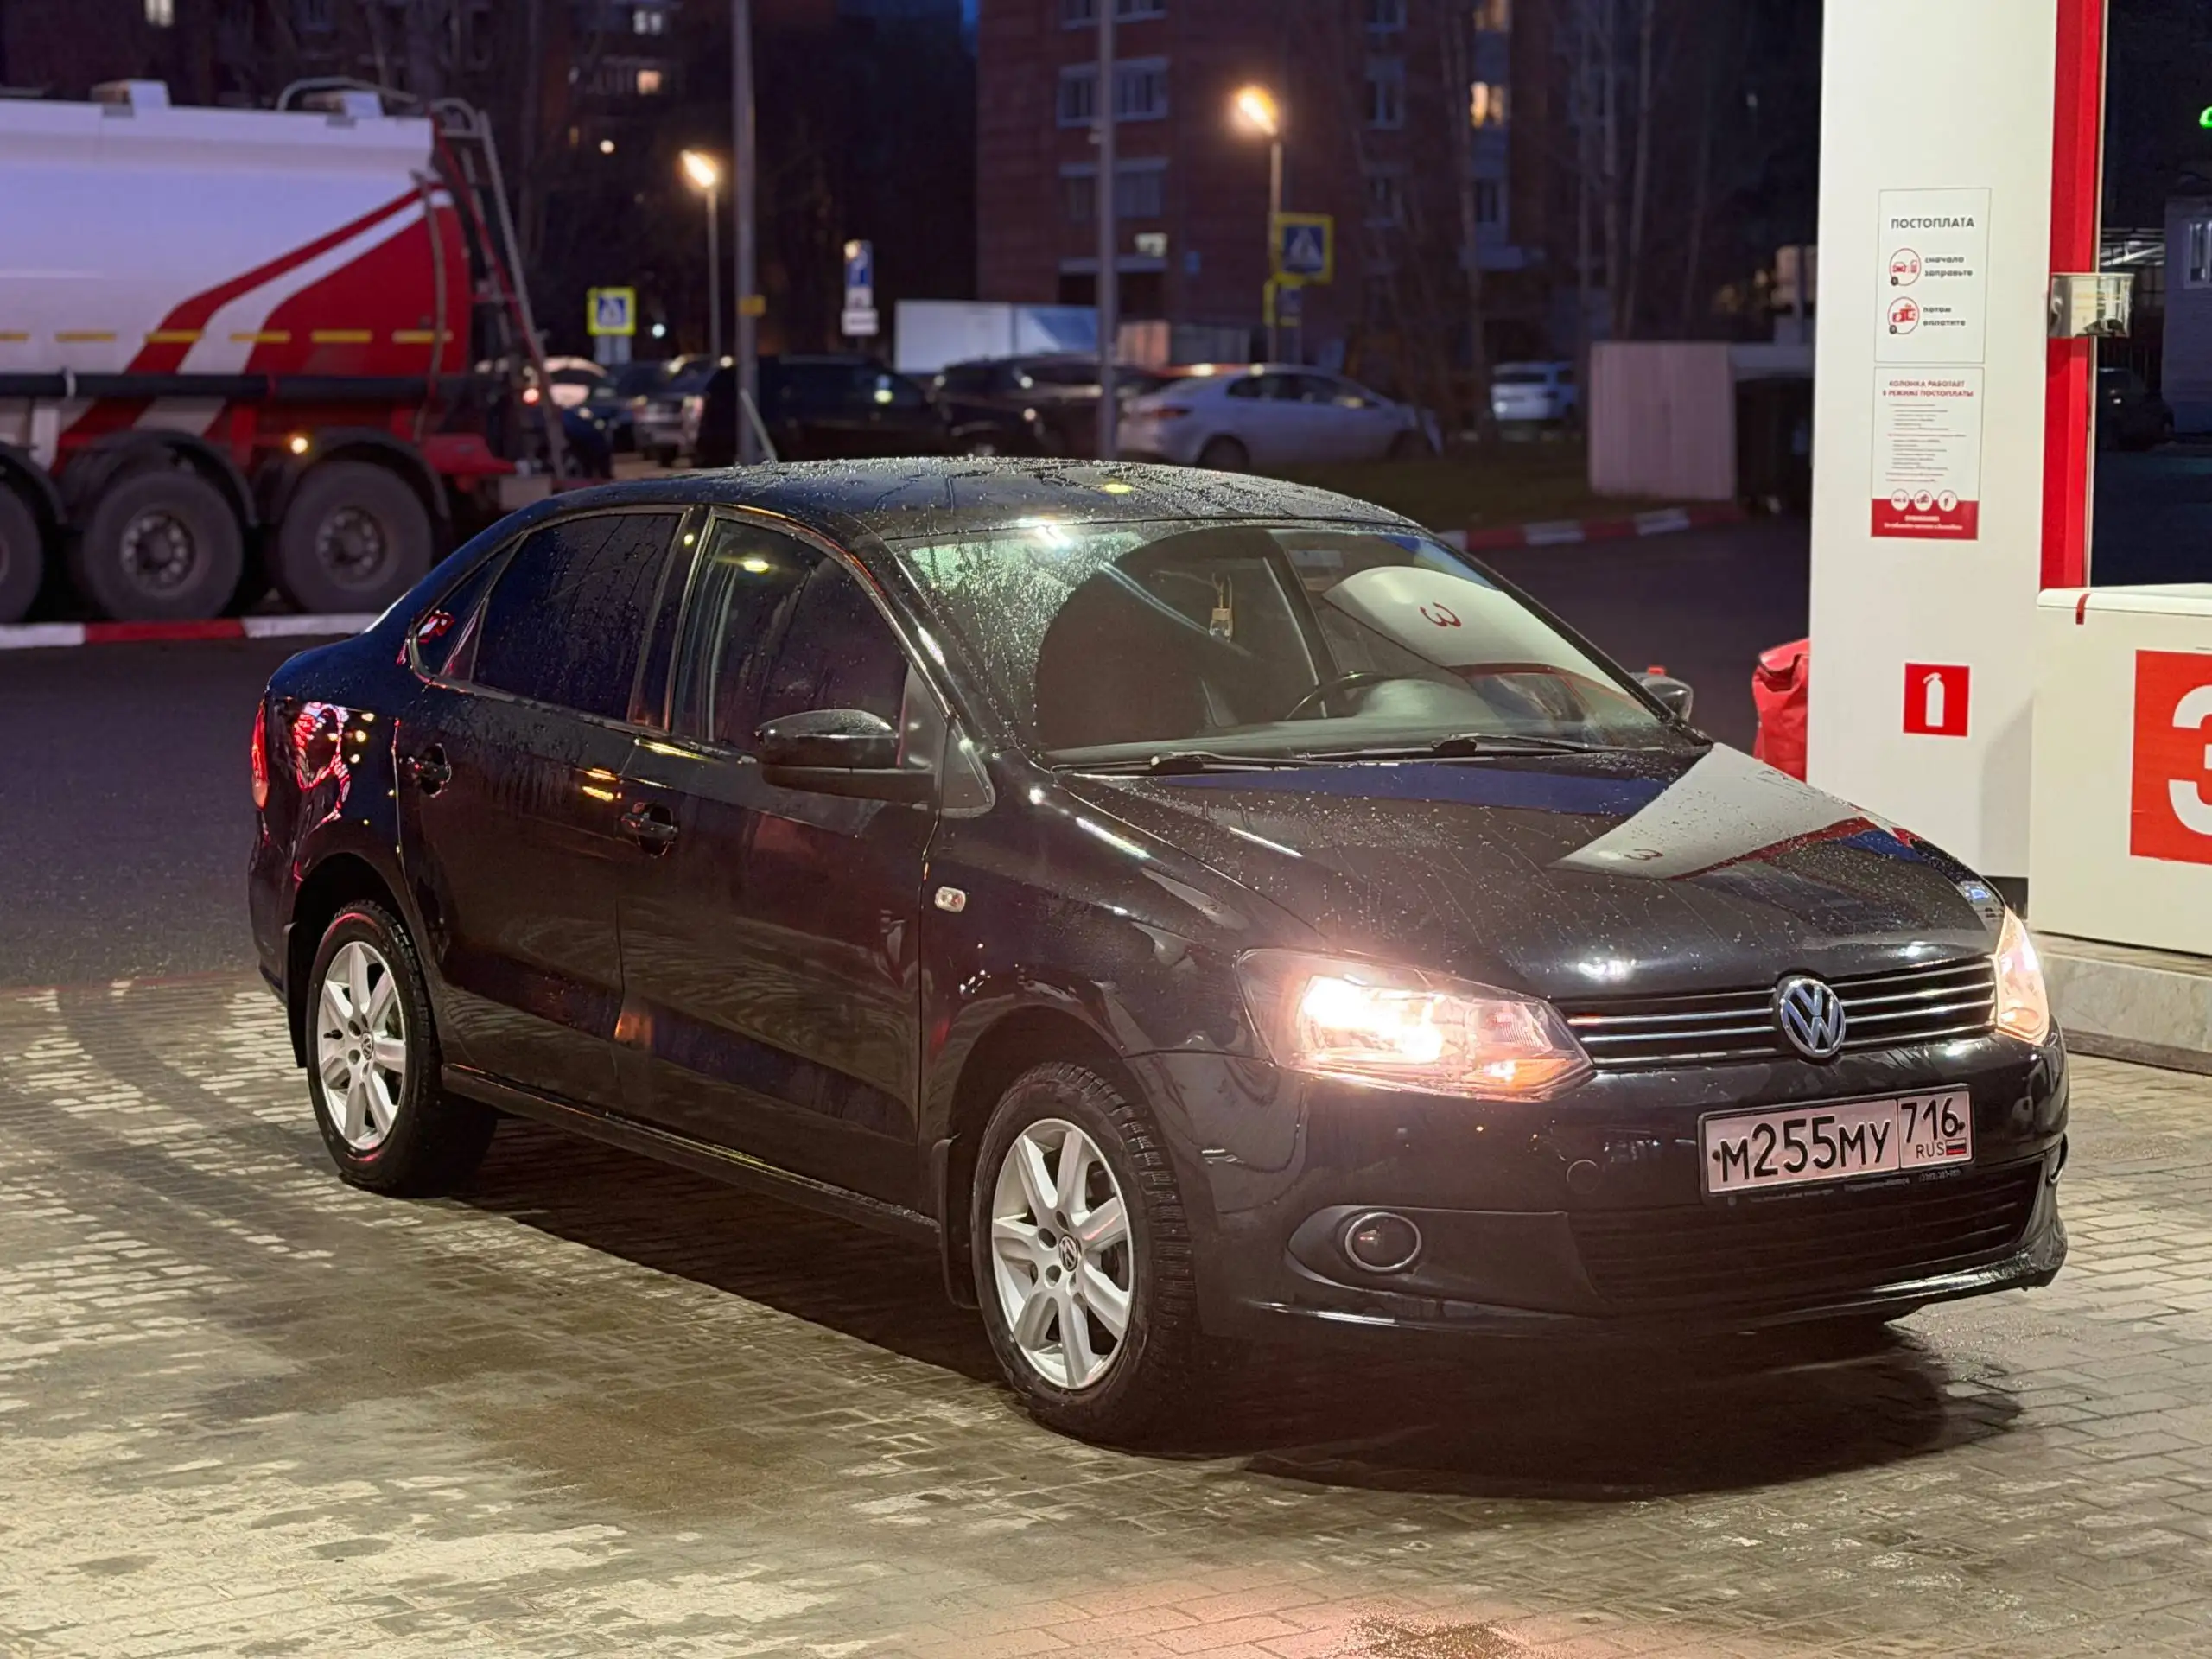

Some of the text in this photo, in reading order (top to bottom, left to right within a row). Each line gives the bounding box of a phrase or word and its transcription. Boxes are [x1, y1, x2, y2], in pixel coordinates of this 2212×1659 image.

[1891, 217, 1975, 229] ПОСТОПЛАТА
[1719, 1097, 1959, 1183] М255МУ 716
[1916, 1141, 1945, 1159] RUS
